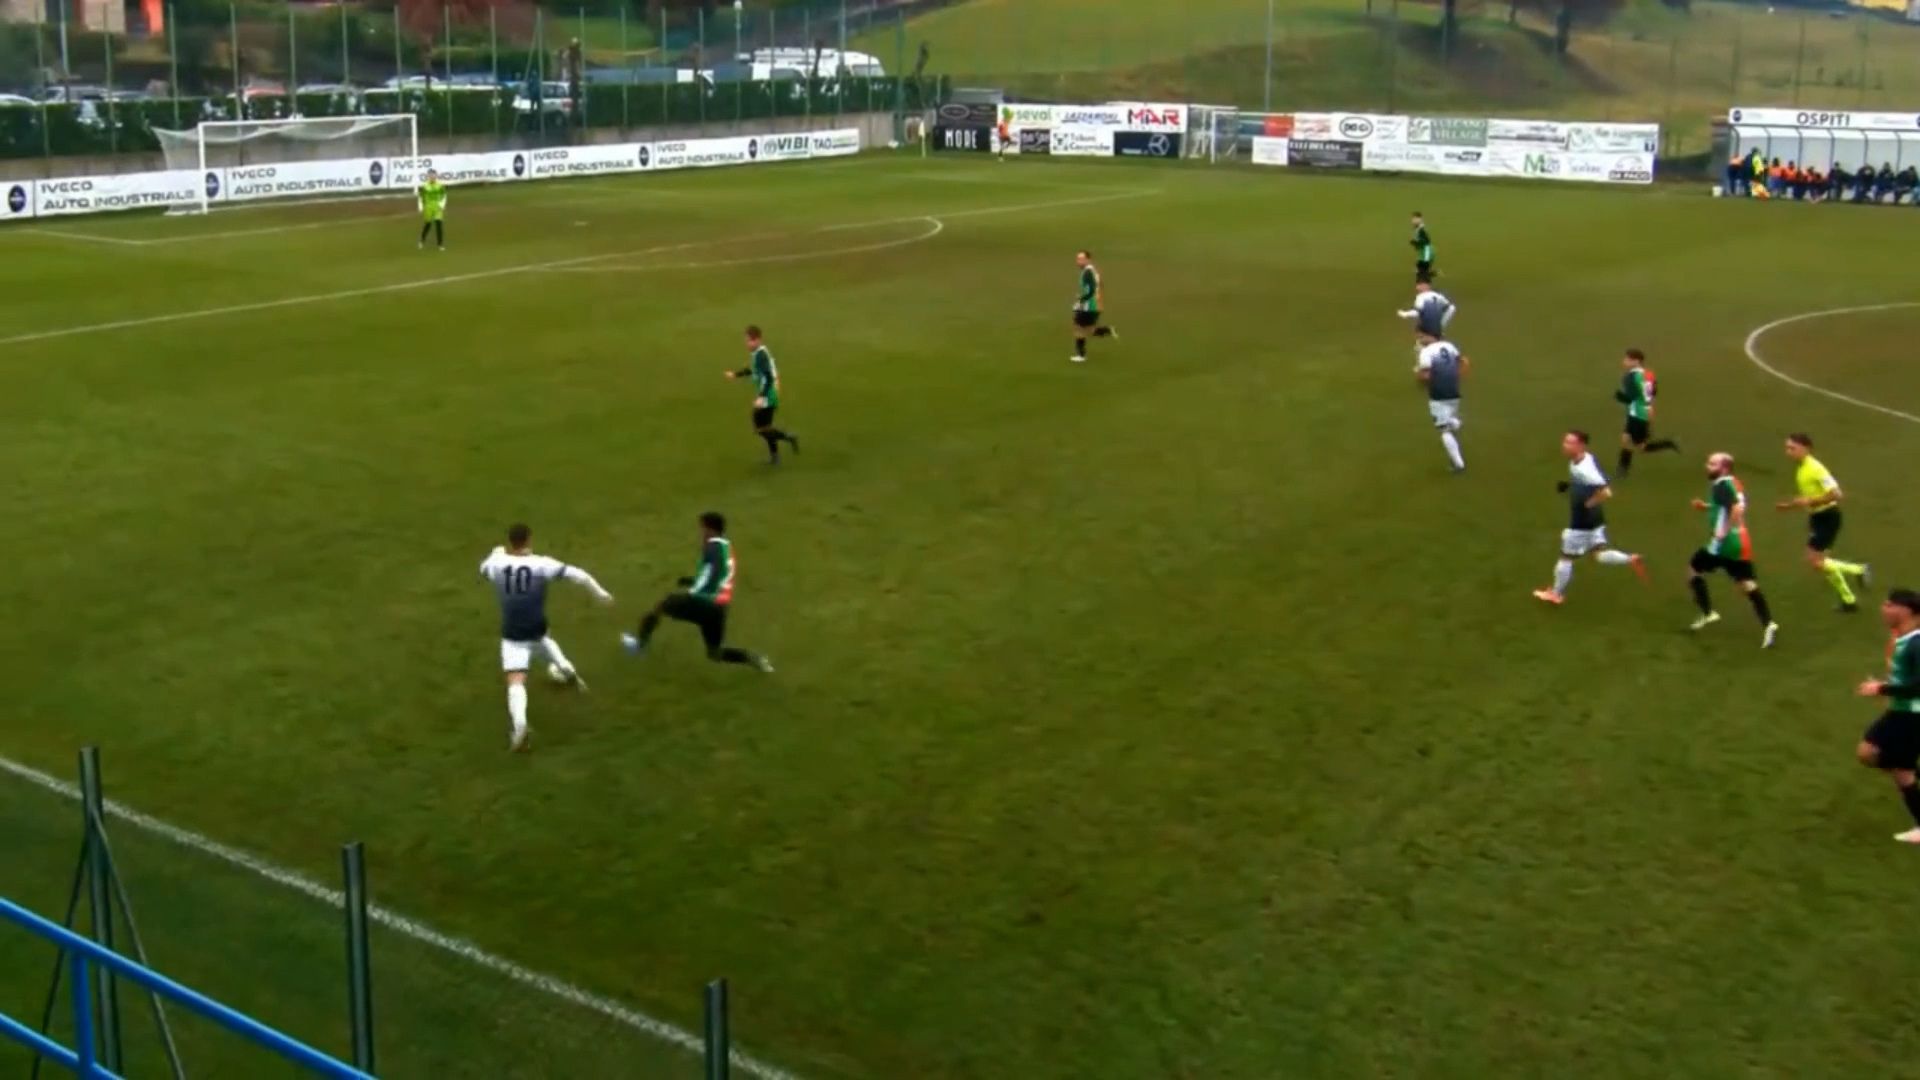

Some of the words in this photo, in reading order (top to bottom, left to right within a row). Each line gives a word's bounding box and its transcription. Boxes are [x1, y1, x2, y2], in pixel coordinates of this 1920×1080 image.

[1127, 108, 1180, 125] MAR
[1796, 111, 1850, 126] OSPITI
[657, 143, 686, 152] IVECO
[777, 136, 809, 150] VIBI
[533, 150, 568, 160] IVECO
[232, 167, 276, 180] IVECO
[535, 164, 565, 174] AUTO
[567, 159, 634, 171] INDUSTRIALE
[41, 181, 93, 193] IVECO
[234, 183, 273, 196] AUTO
[276, 177, 363, 192] INDUSTRIALE
[43, 199, 90, 210] AUTO
[94, 190, 195, 207] INDUSTRIALE
[502, 564, 532, 594] 10
